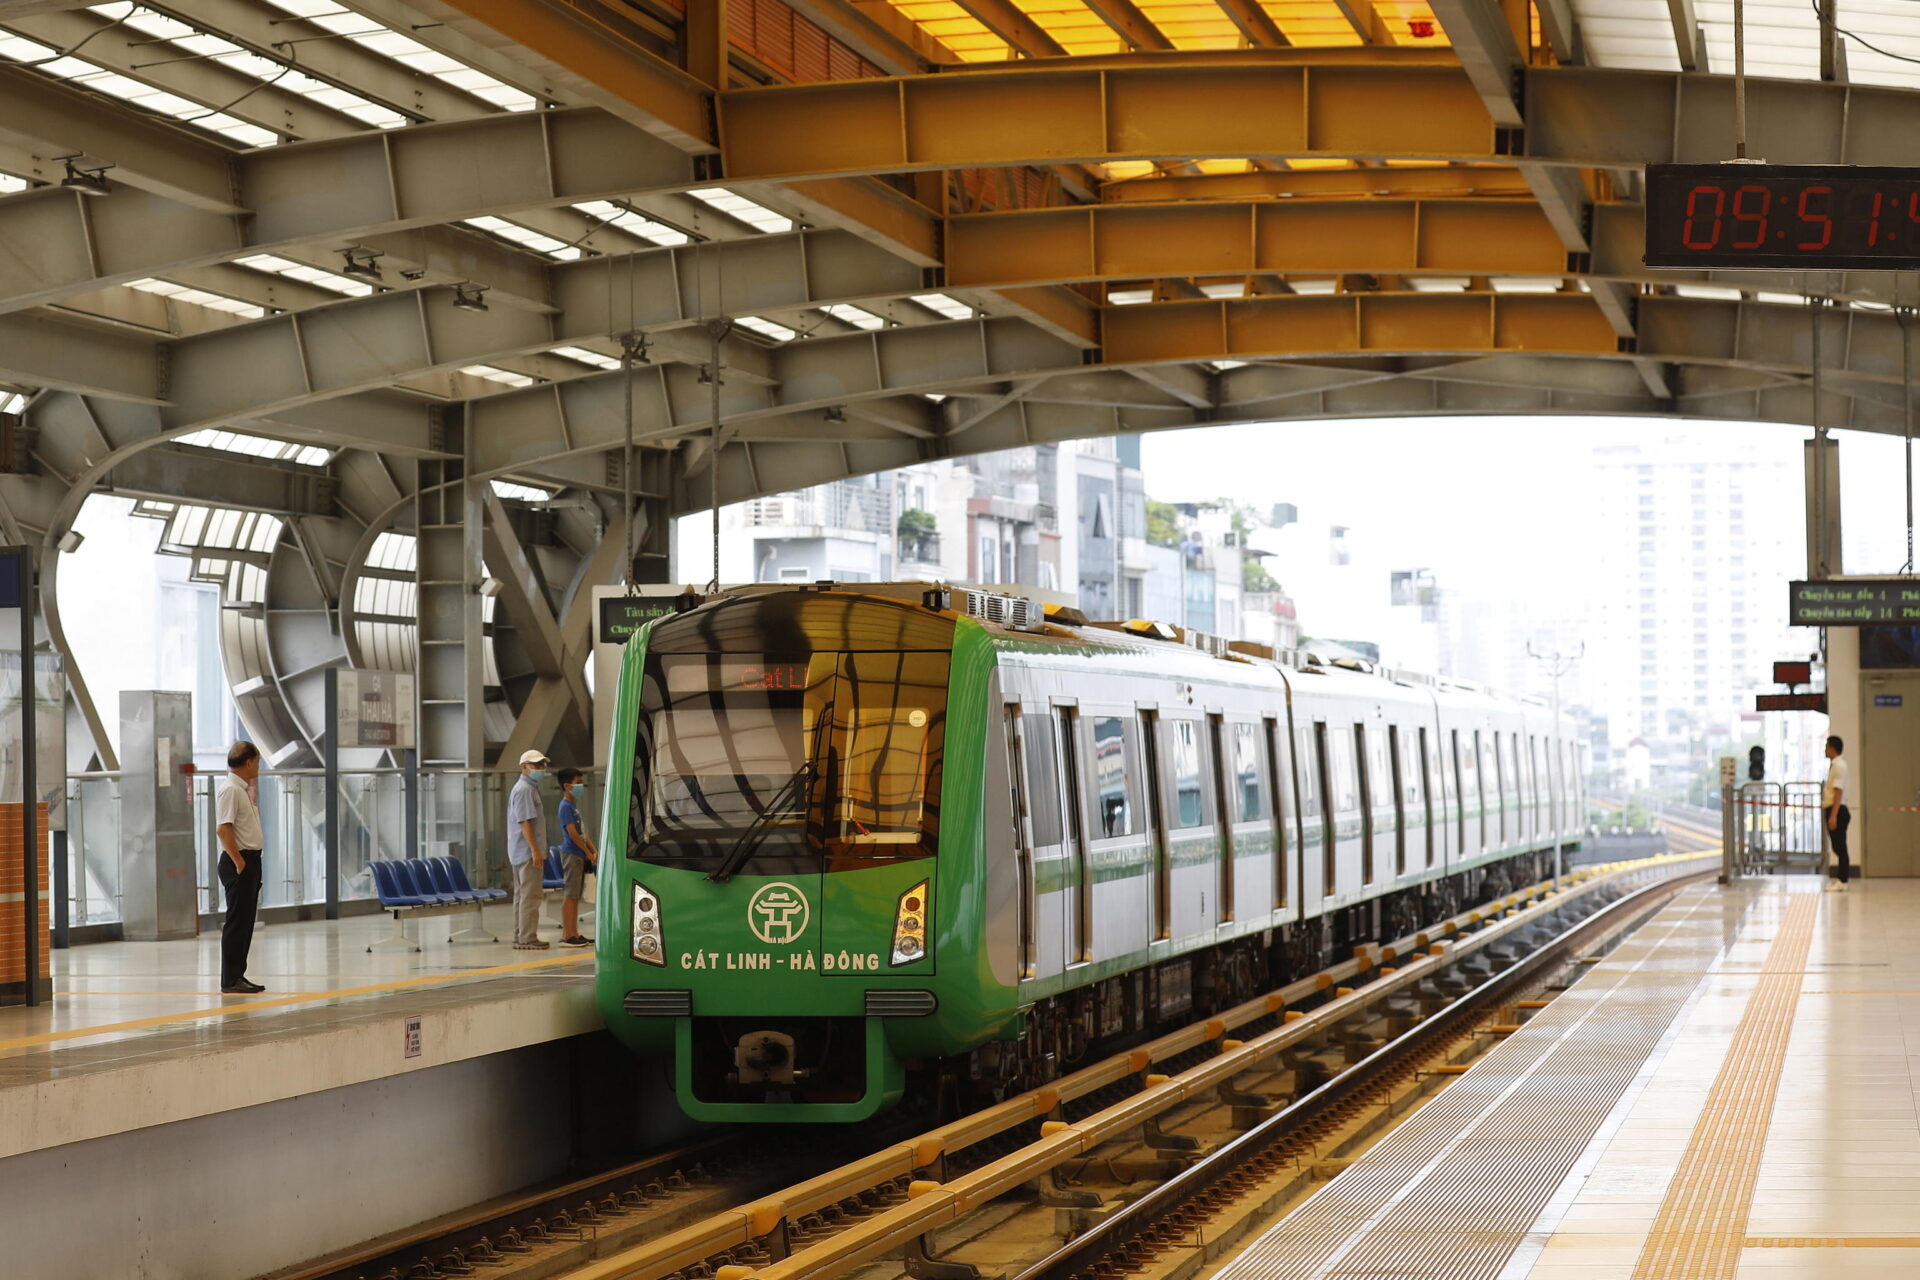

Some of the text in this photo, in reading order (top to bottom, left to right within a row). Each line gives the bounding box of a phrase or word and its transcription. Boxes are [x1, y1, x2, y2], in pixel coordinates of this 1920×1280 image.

[624, 607, 644, 617] Tàu
[741, 667, 783, 688] Cat
[681, 949, 719, 969] CÁT
[727, 953, 771, 969] LINH
[790, 950, 816, 969] HÀ
[823, 950, 879, 970] ĐÔNG
